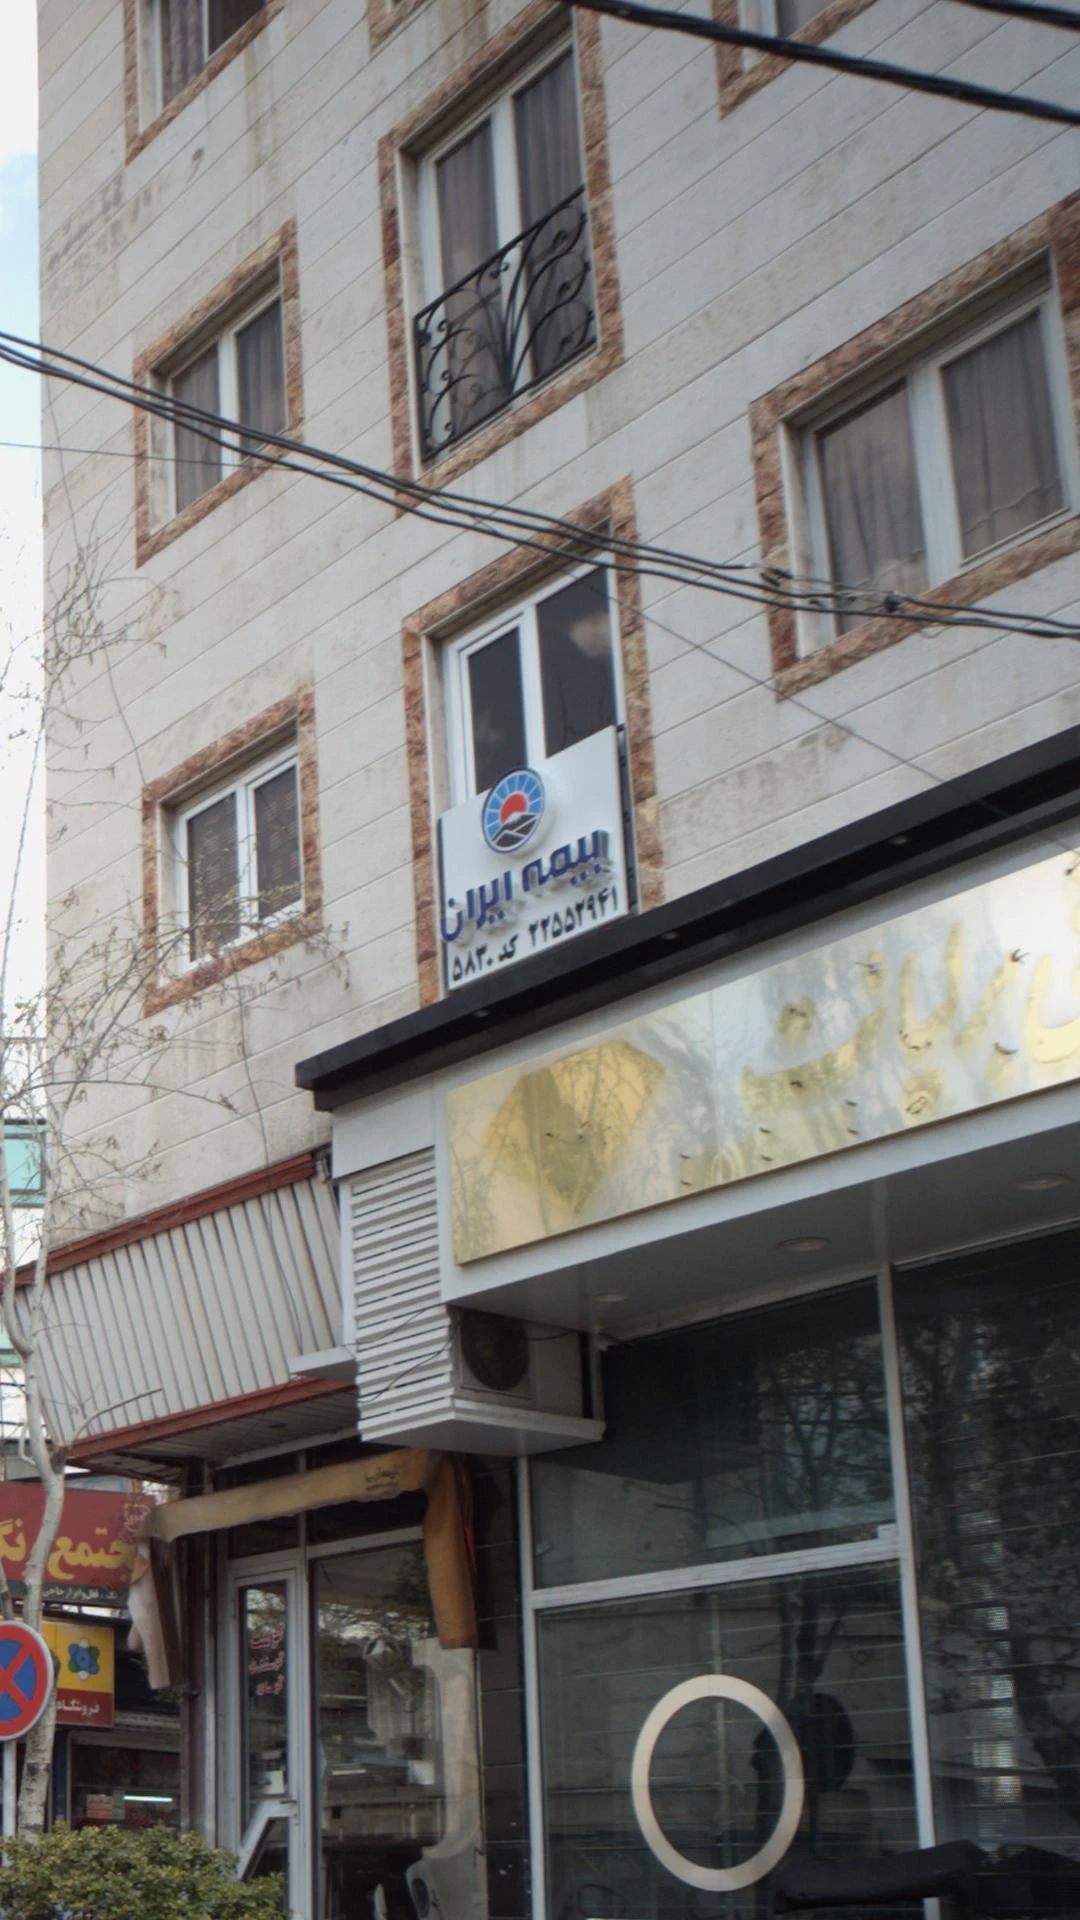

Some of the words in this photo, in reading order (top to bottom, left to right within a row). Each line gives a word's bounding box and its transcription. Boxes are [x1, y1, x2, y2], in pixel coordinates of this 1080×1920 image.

[522, 829, 607, 892] بیمه
[441, 870, 513, 942] ایران
[498, 933, 519, 962] کد
